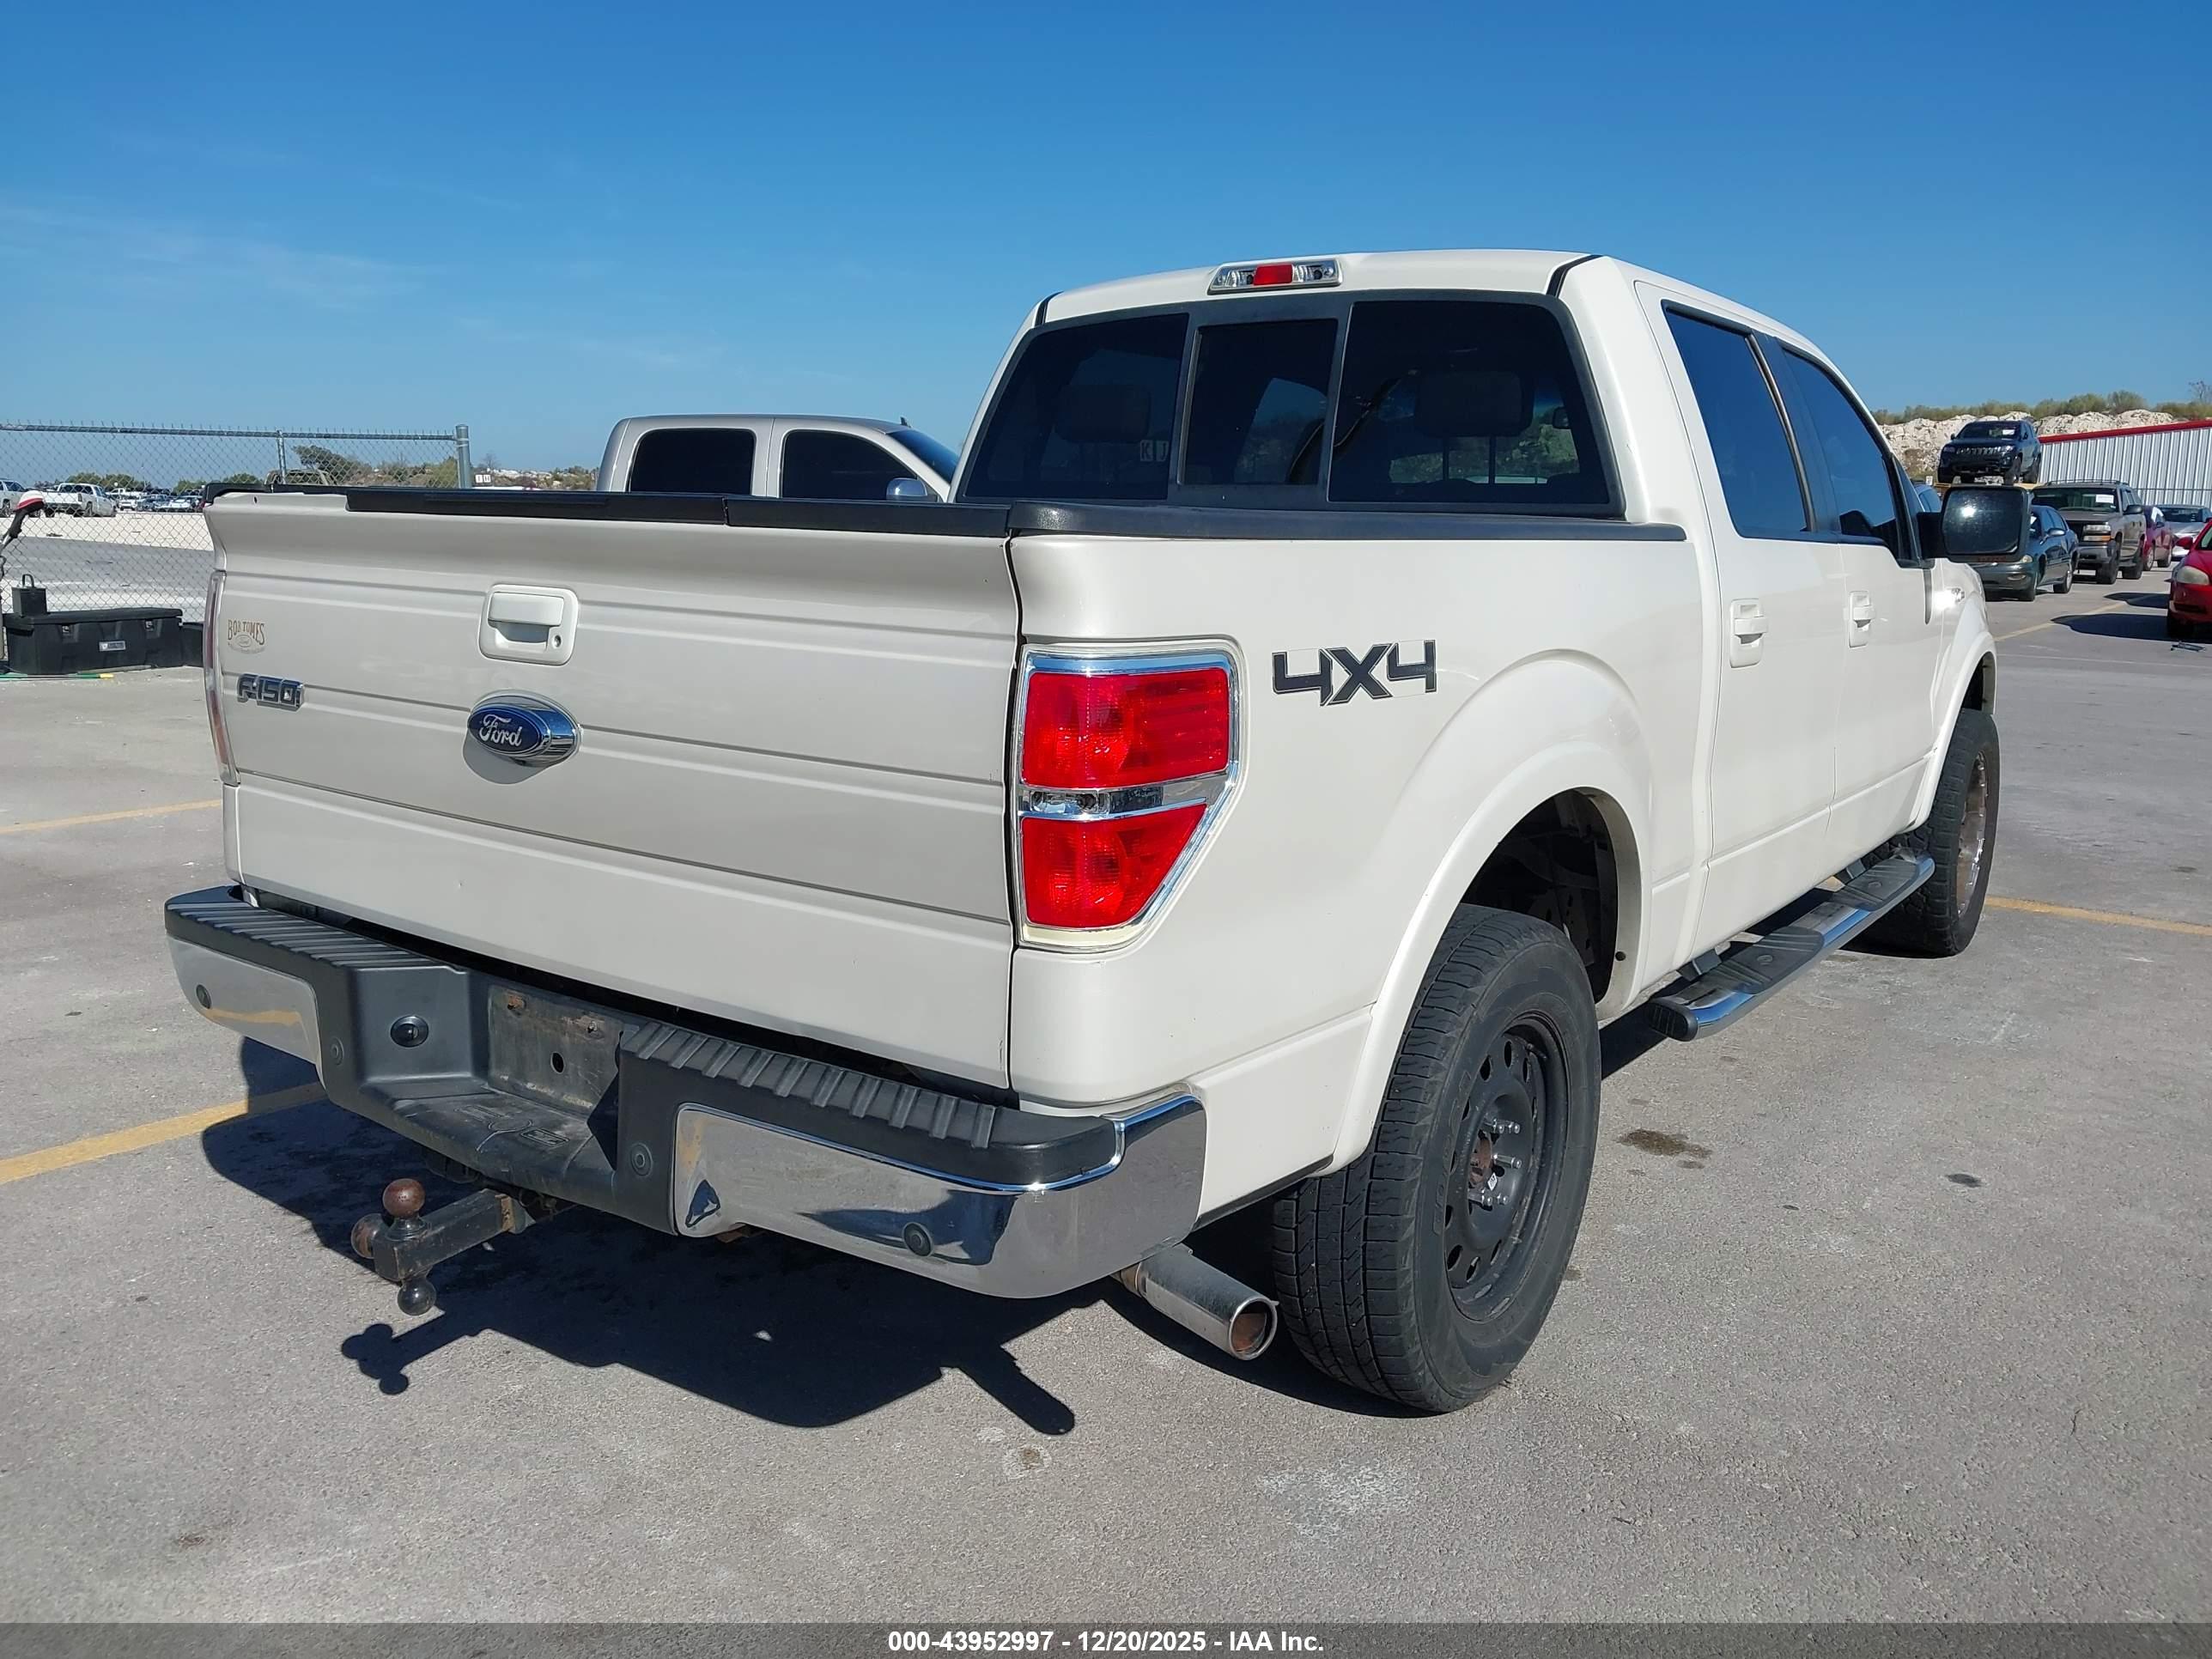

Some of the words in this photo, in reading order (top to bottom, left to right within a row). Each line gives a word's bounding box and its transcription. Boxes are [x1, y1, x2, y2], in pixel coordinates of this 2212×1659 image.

[242, 621, 265, 646] TOMES
[1272, 640, 1437, 707] 4X4
[479, 714, 522, 747] Ford
